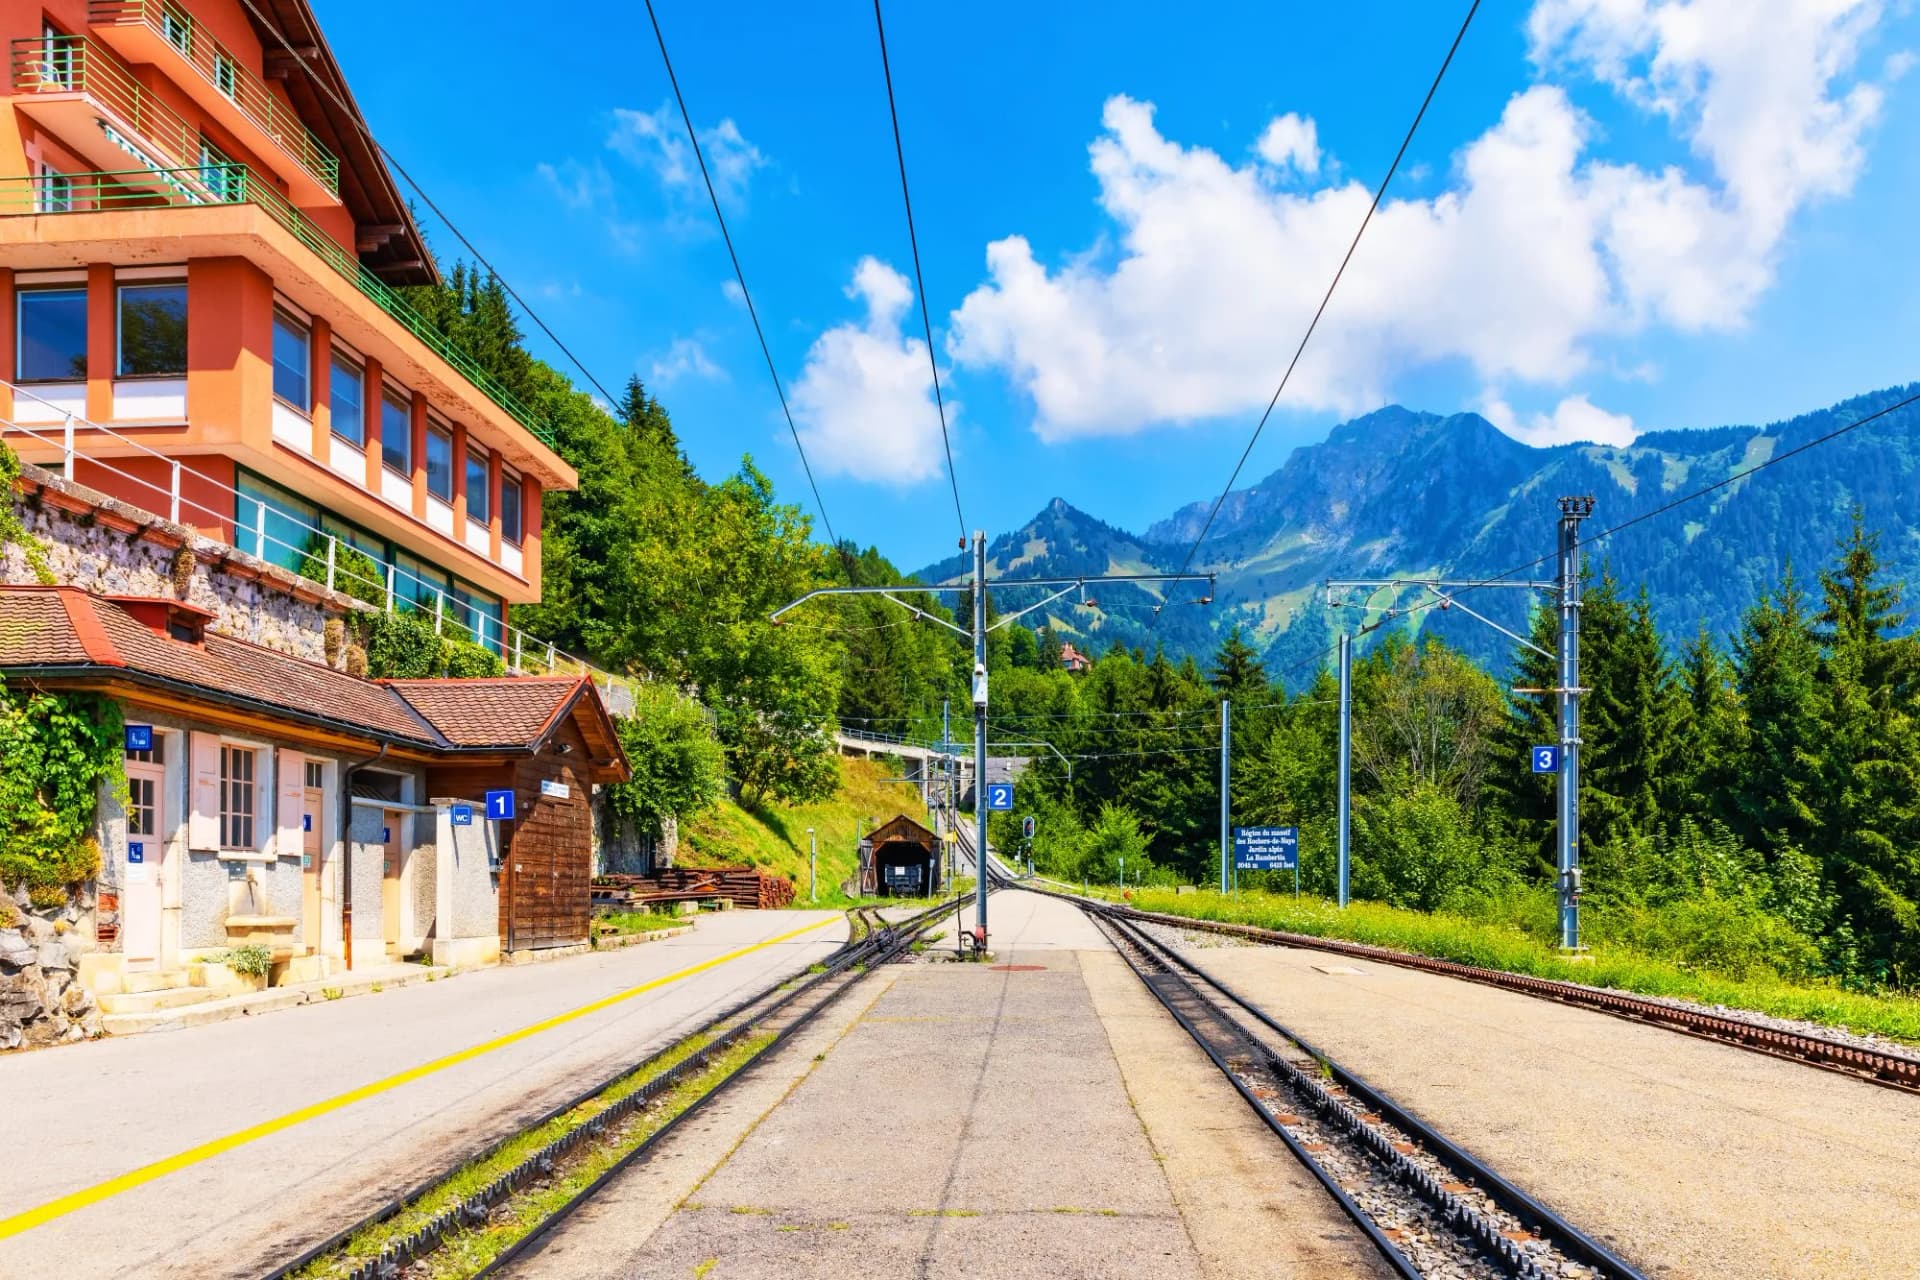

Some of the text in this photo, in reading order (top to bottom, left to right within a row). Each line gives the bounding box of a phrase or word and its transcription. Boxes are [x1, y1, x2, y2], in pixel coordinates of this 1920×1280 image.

[1539, 751, 1552, 768] 3
[995, 789, 1006, 805] 2
[495, 796, 505, 815] 1
[455, 814, 468, 822] WC
